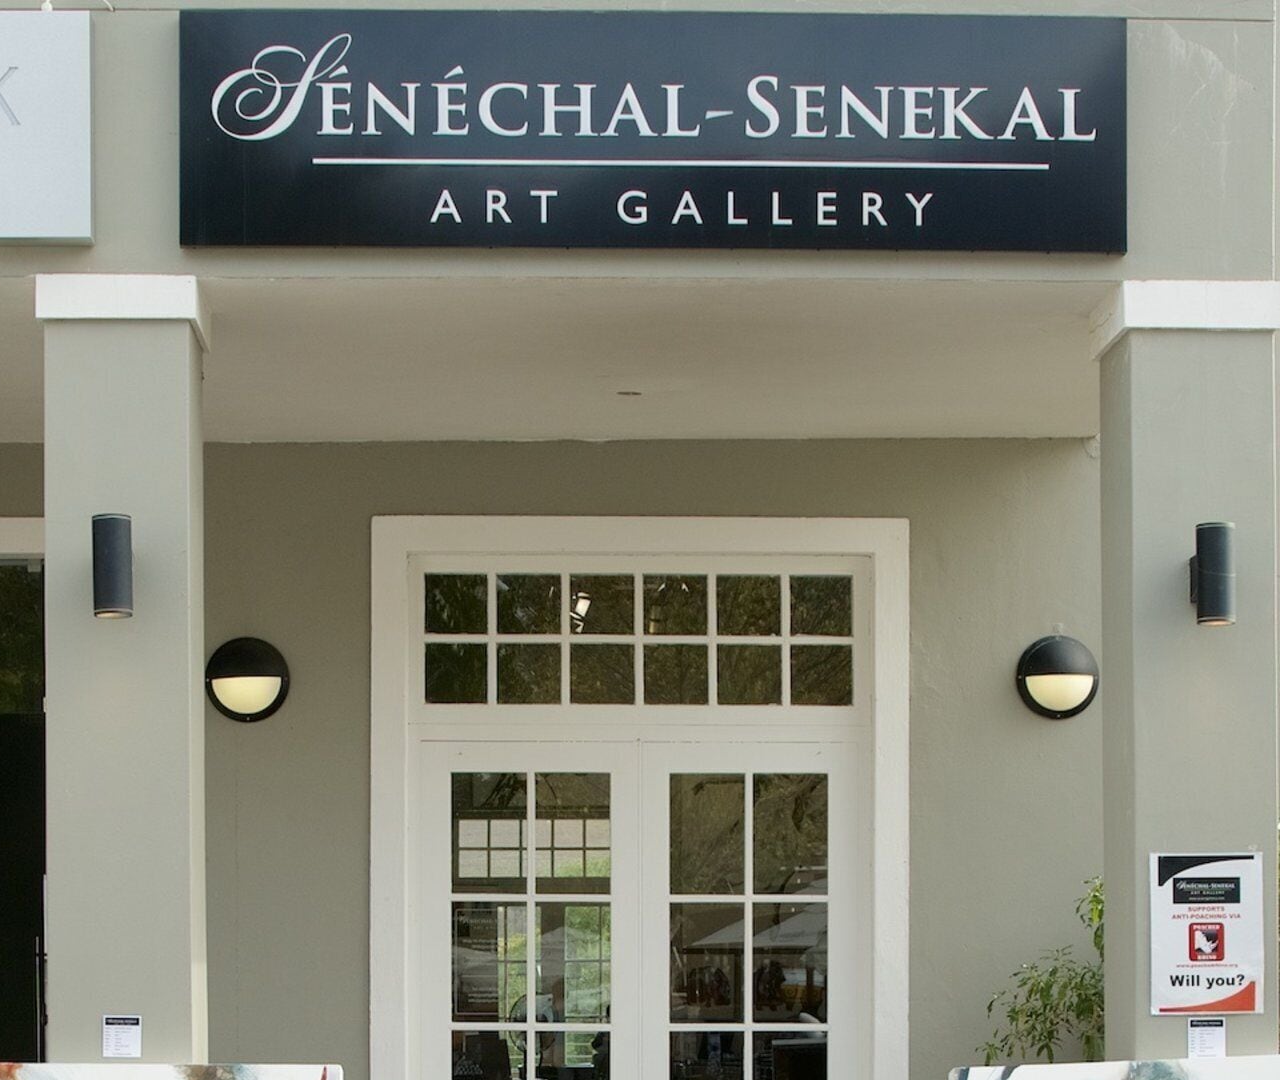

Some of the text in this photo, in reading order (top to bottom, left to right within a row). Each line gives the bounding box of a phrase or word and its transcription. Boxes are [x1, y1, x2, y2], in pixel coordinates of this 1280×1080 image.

[211, 33, 1097, 142] SÉNÉCHAL-SENEKAL
[430, 190, 934, 227] ART GALLERY
[1170, 973, 1245, 990] Will you?
